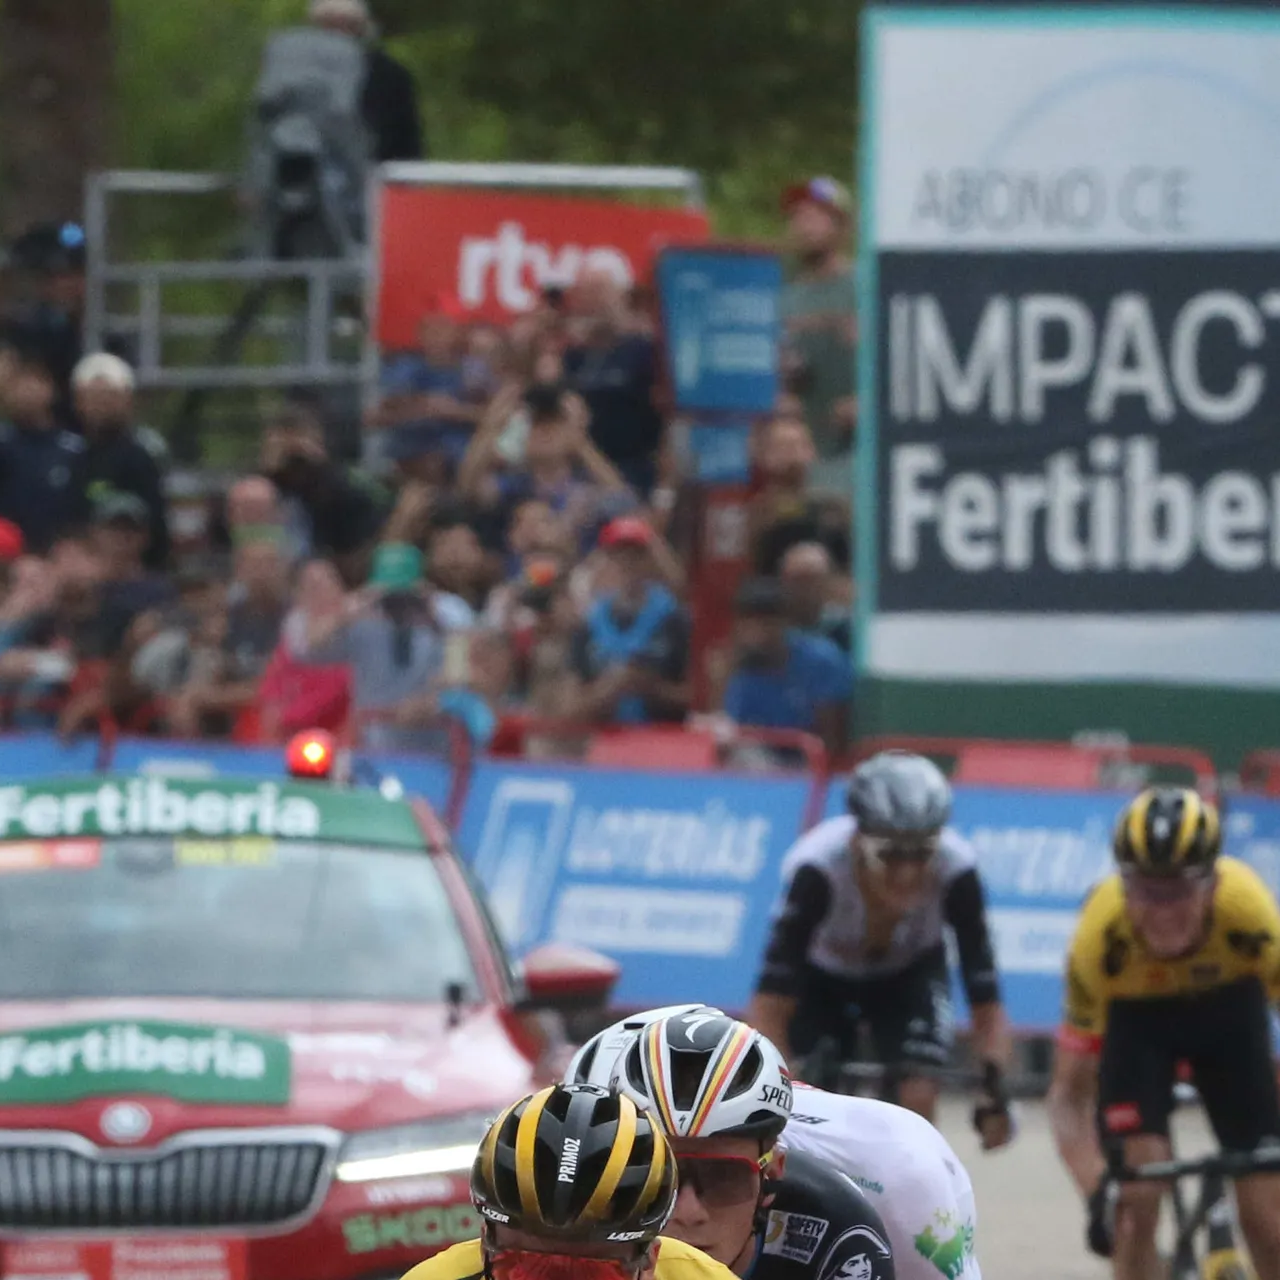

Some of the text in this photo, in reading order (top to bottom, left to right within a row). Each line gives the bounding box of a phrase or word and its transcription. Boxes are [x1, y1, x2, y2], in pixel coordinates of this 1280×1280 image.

[910, 166, 1103, 234] ABONO
[558, 1137, 581, 1183] PRIMOZ
[481, 1205, 510, 1225] LAZER
[606, 1230, 646, 1242] LAZER
